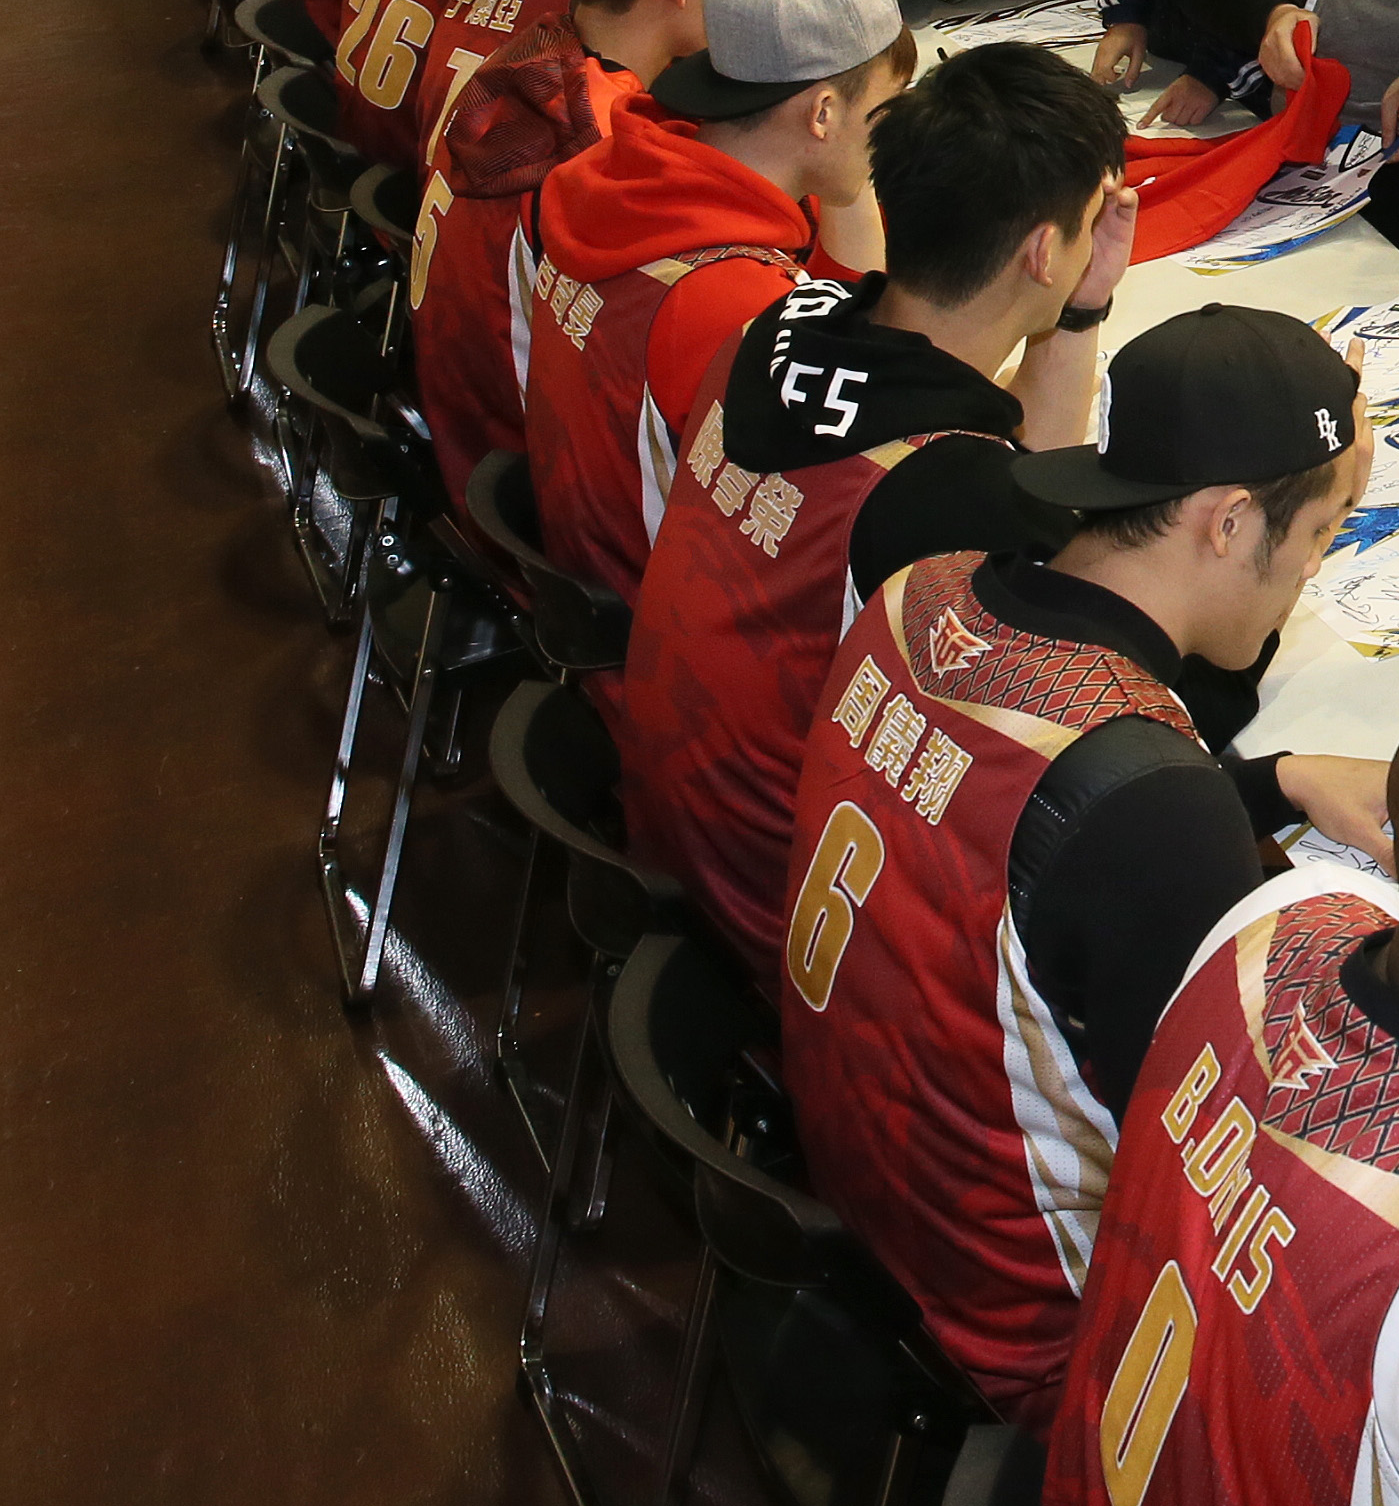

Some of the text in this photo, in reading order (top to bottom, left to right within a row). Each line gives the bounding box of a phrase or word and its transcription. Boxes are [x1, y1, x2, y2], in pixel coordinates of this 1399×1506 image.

[830, 654, 975, 827] 周儀翔
[787, 800, 886, 1012] 6
